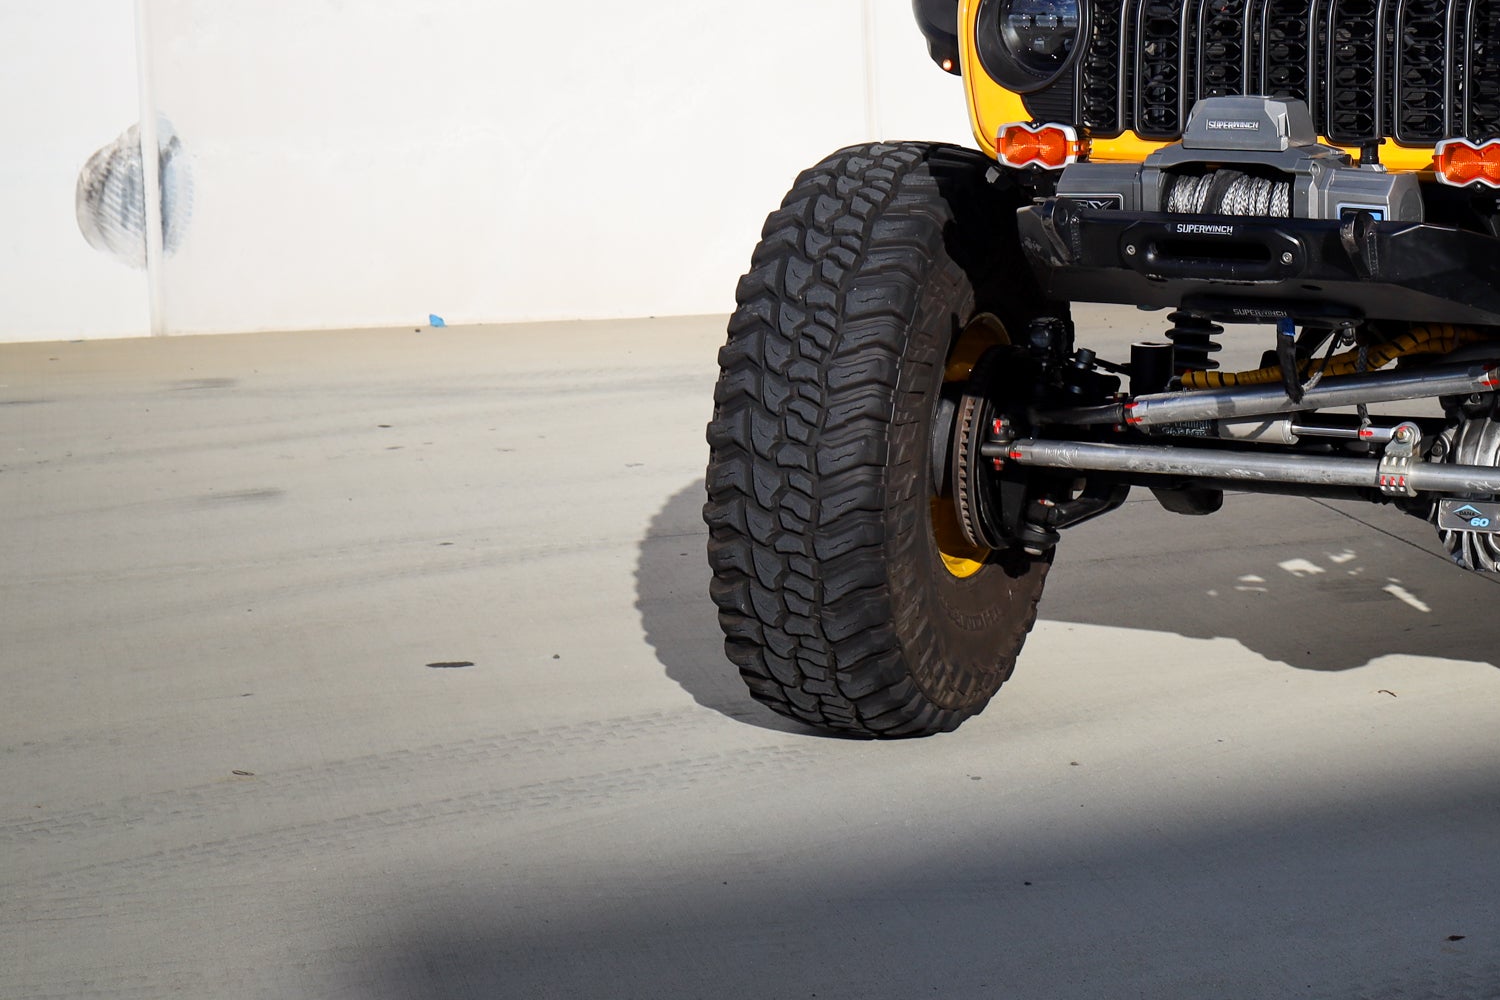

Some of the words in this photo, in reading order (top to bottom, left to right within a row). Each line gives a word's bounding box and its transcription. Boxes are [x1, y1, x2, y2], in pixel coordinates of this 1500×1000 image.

[1208, 120, 1259, 130] SUPERWINCH
[1176, 223, 1233, 234] SUPERWINCH
[1470, 517, 1490, 528] 60
